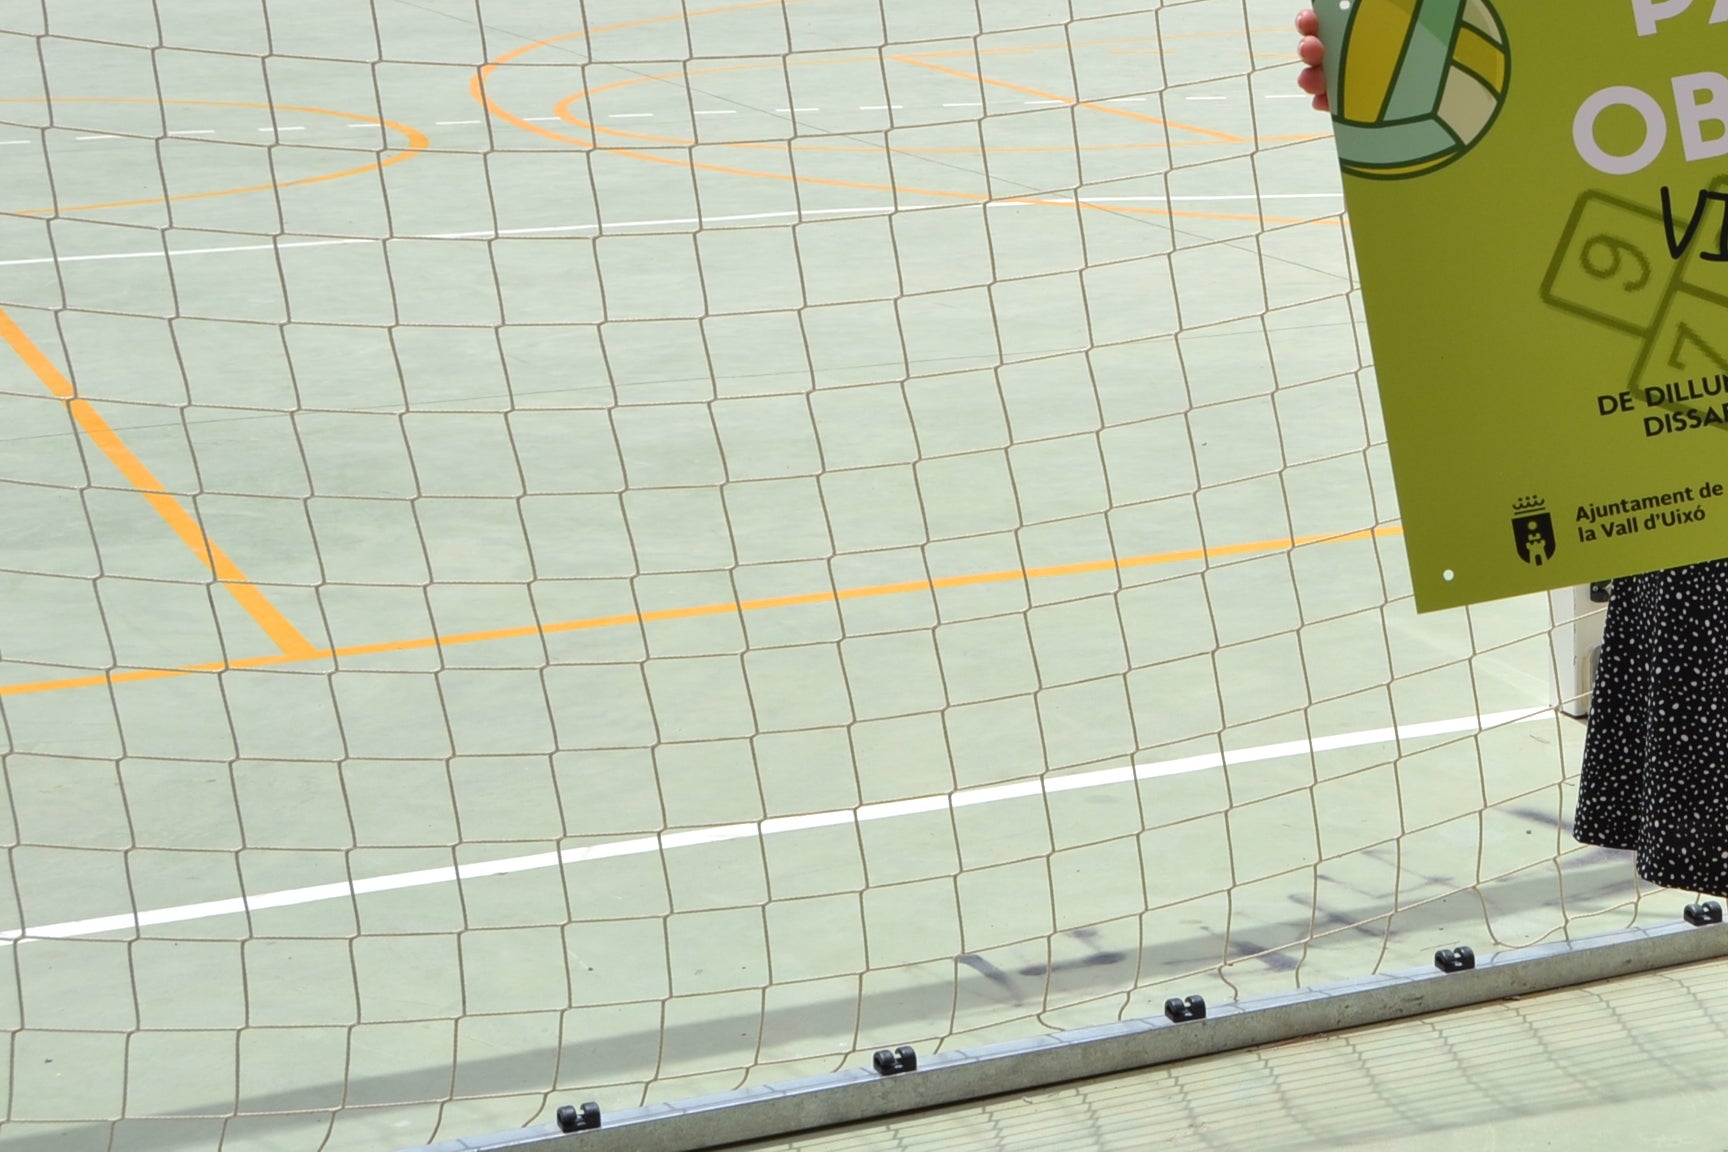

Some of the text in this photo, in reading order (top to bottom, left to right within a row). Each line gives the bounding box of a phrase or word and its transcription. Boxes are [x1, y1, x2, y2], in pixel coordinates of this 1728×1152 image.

[1597, 391, 1635, 416] DE
[1575, 481, 1724, 524] Ajuntament de
[1578, 504, 1706, 543] la Vall d'Uixó
